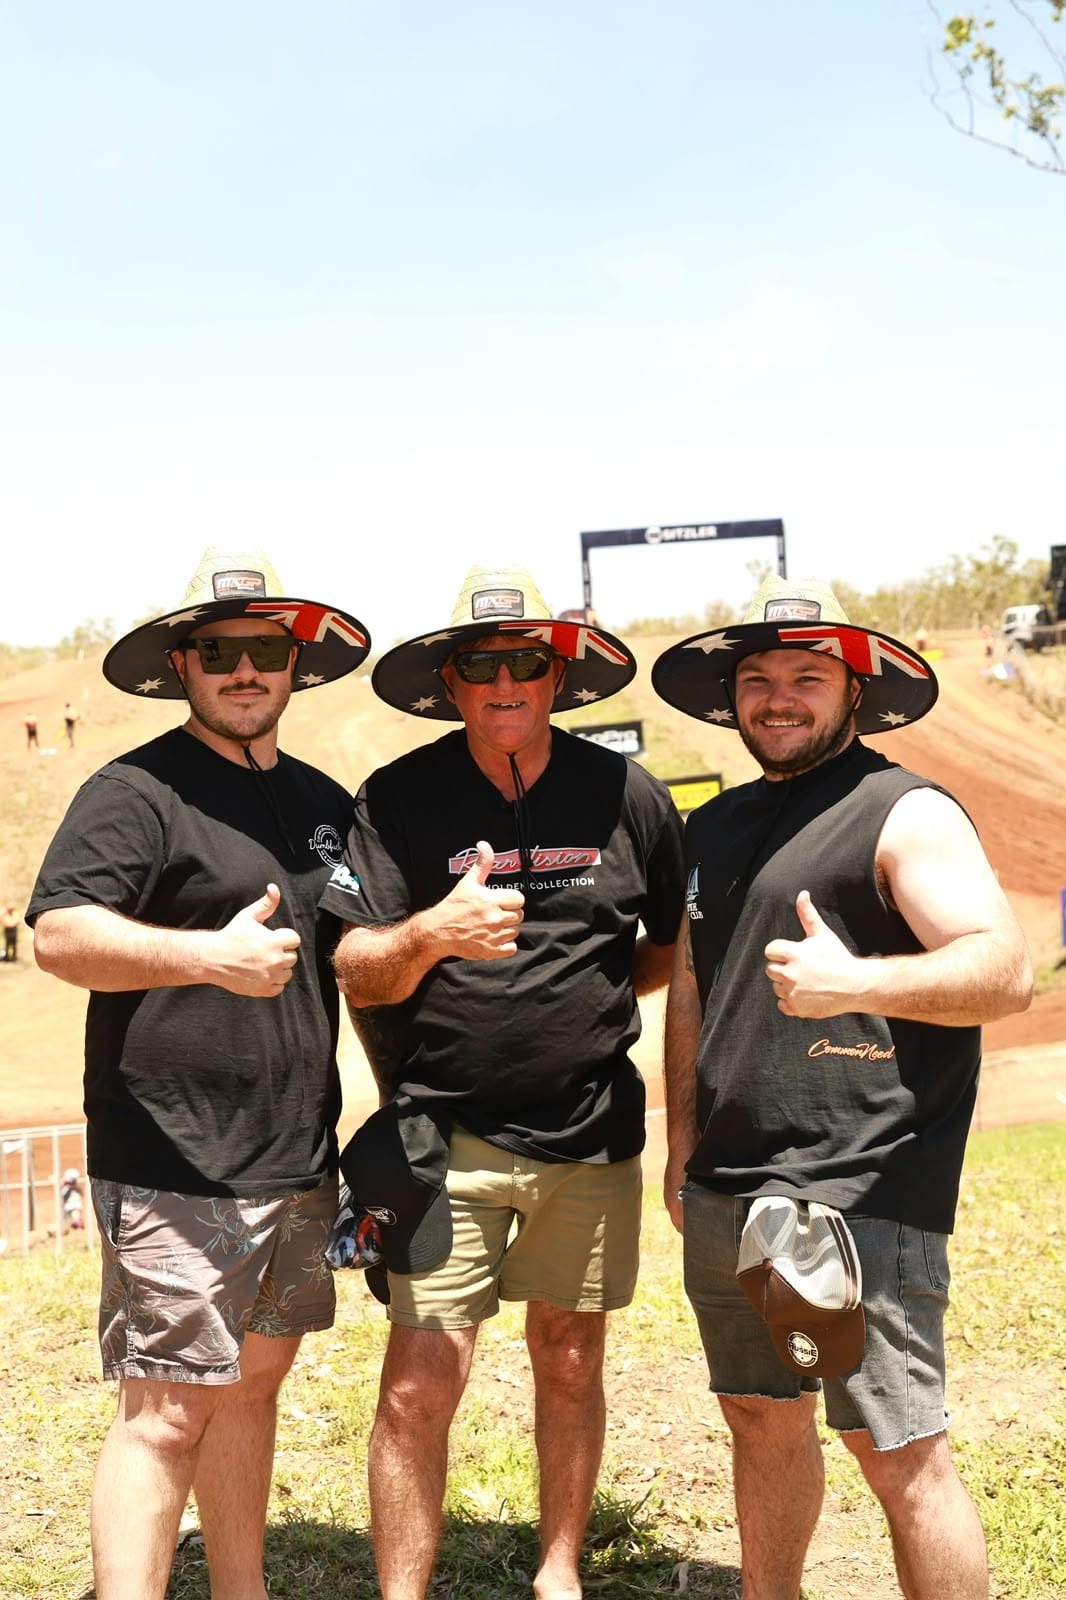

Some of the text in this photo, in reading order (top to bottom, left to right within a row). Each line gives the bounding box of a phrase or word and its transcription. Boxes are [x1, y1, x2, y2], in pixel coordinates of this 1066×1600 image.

[455, 847, 517, 875] Rar
[487, 877, 595, 891] OLDEN COLLECTION
